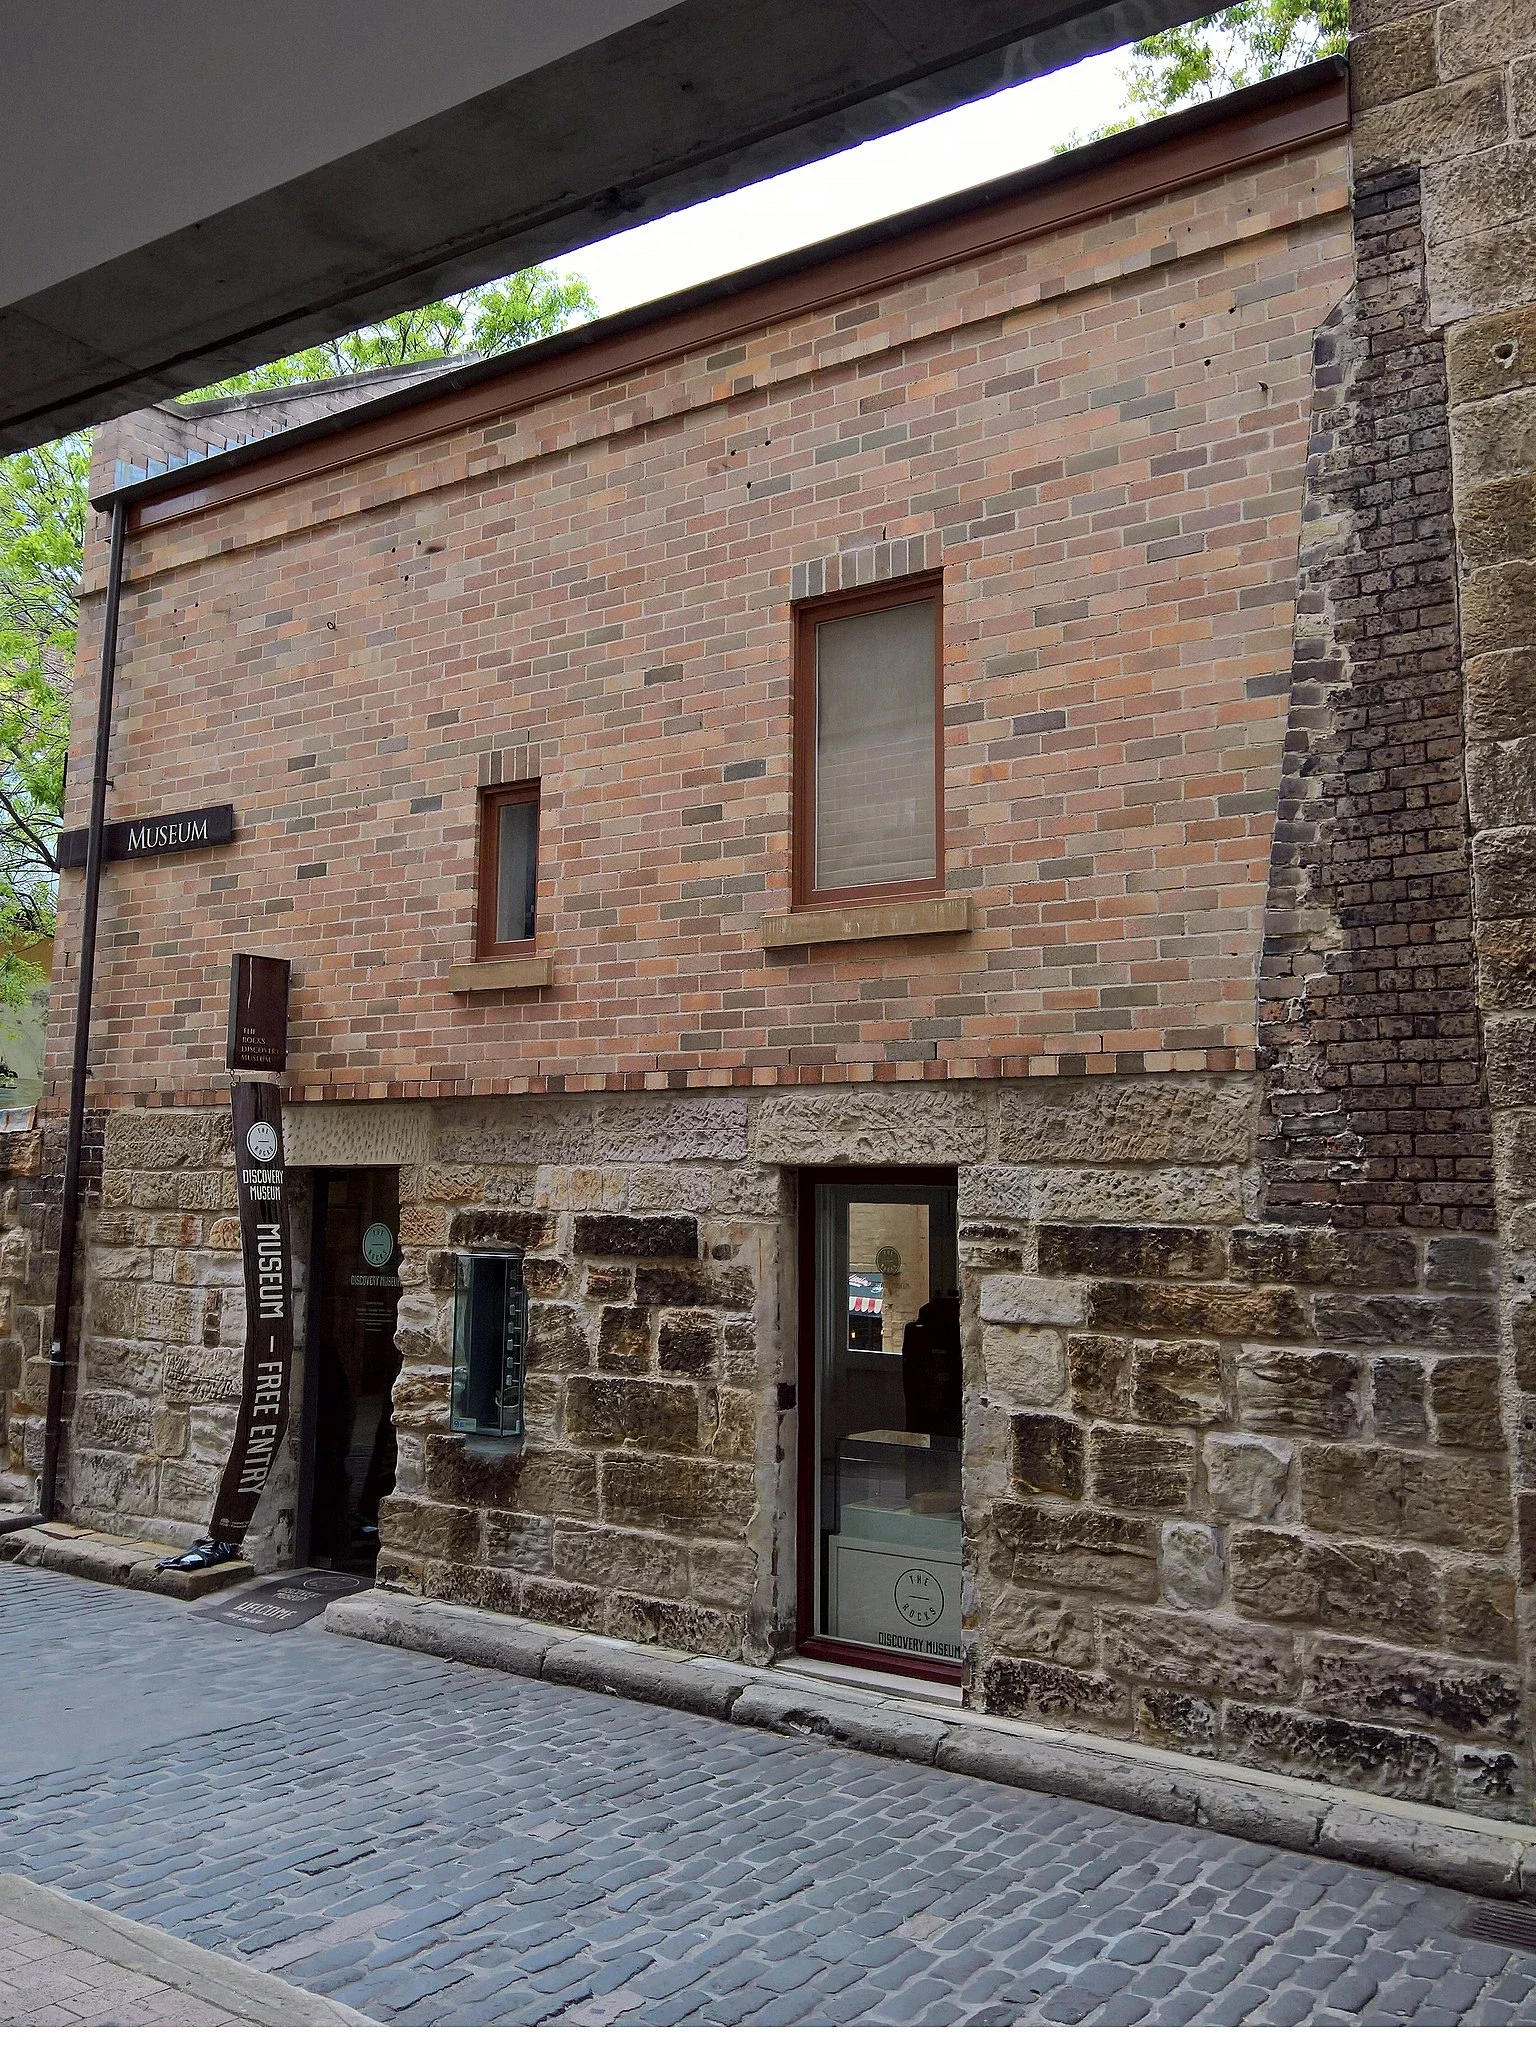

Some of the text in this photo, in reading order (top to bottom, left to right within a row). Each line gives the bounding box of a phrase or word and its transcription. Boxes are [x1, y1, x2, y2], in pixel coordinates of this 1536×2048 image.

[127, 819, 208, 851] MUSEUM
[241, 1045, 280, 1055] DISCOVERY
[242, 1036, 266, 1045] ROCKS
[241, 1054, 271, 1063] MUSEUM
[242, 1169, 283, 1185] DISCOVERY
[249, 1185, 281, 1201] MUSEUM
[256, 1223, 284, 1319] MUSEUM
[252, 1360, 283, 1417] FREE
[237, 1424, 277, 1494] ENTRY
[909, 1575, 929, 1587] THE
[233, 1601, 299, 1620] WELCOME
[902, 1602, 936, 1622] ROCKS
[878, 1631, 961, 1659] DISCOVERY MUSEUM
